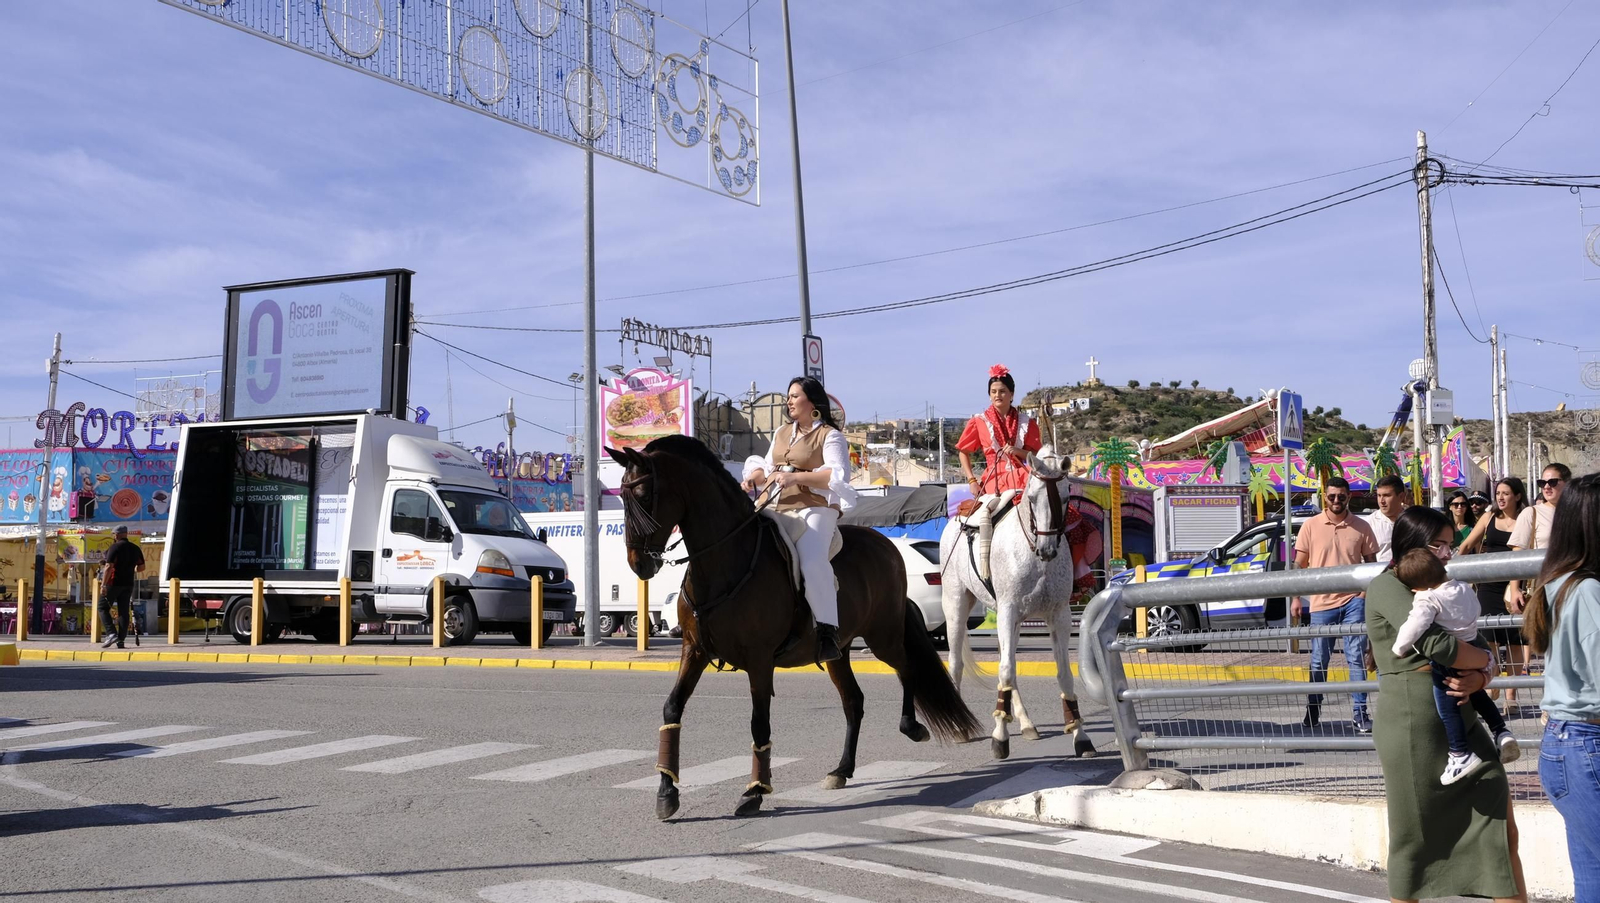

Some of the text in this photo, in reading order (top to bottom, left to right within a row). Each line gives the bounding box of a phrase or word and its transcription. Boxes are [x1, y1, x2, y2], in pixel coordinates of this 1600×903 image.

[289, 301, 323, 320] Ascen
[317, 320, 339, 329] CENTRO
[330, 306, 370, 334] APERTURA
[288, 320, 315, 339] Goca
[316, 328, 338, 337] DENTAL
[102, 456, 175, 474] CHURRE
[235, 484, 279, 493] ESPECIALISTAS
[1172, 498, 1202, 506] SACAR
[536, 524, 585, 538] CNFITER
